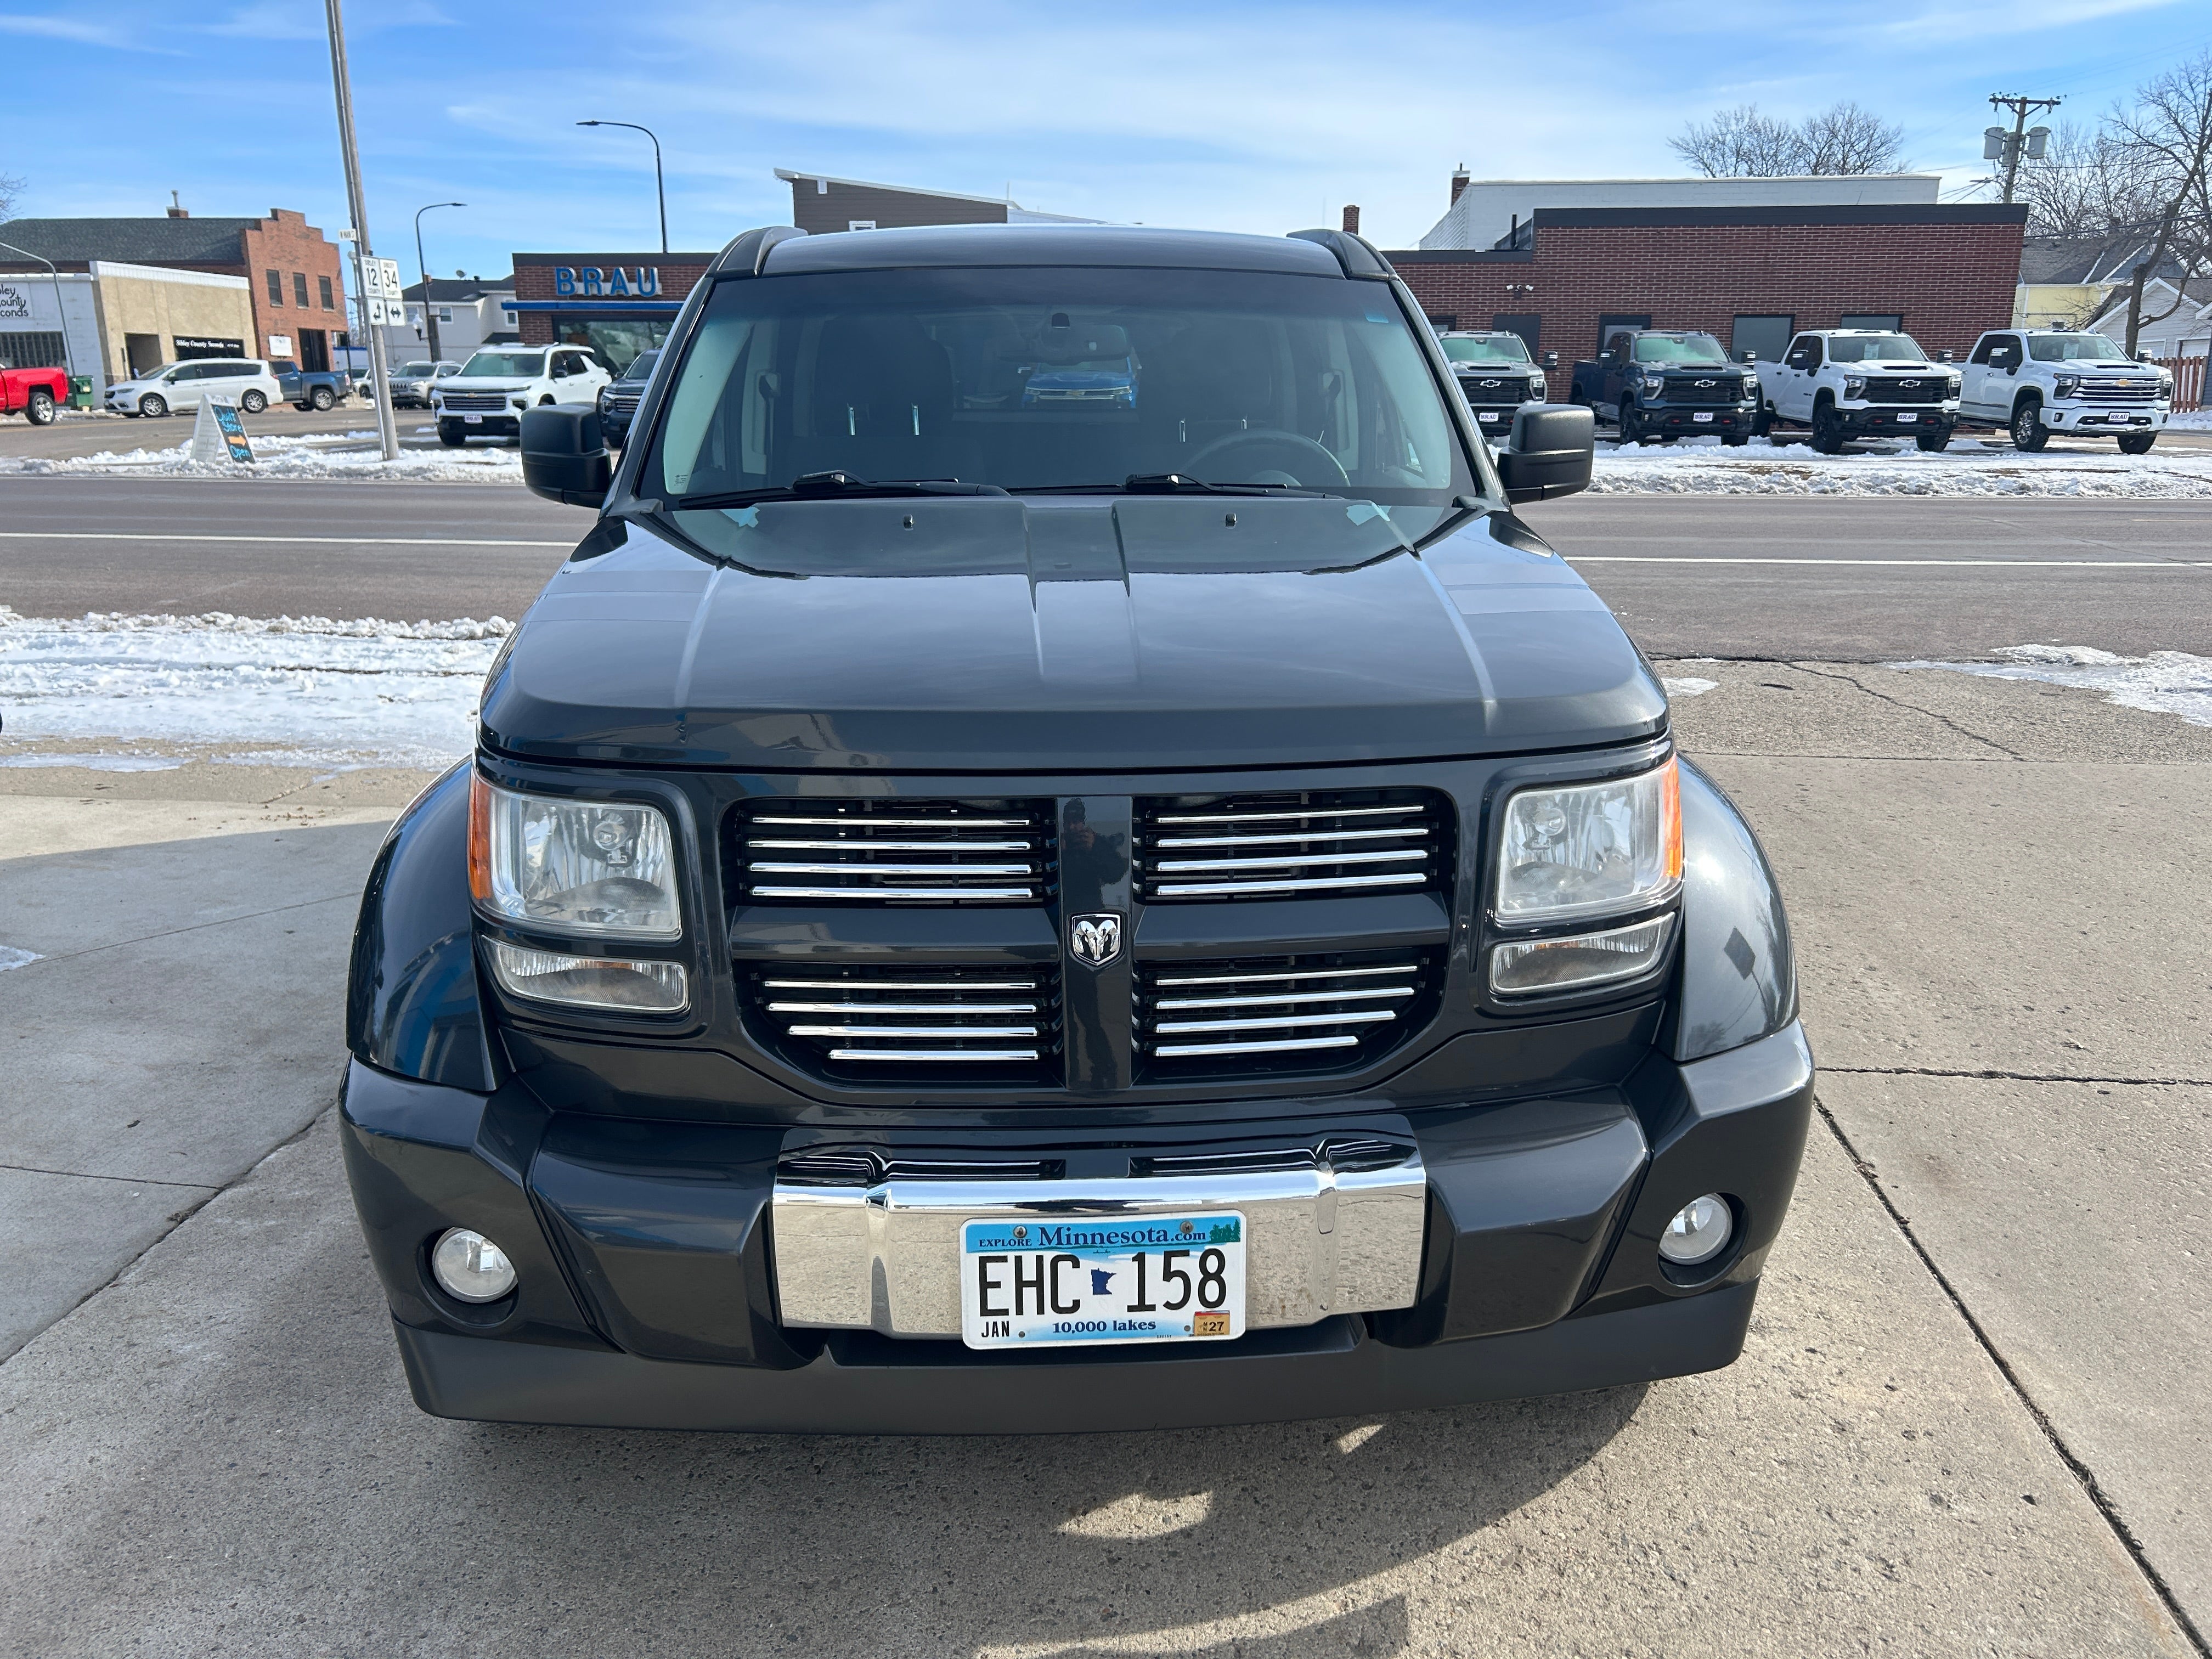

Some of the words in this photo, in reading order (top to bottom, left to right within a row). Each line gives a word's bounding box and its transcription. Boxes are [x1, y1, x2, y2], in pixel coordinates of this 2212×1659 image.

[366, 268, 378, 286] 12
[384, 270, 398, 288] 34
[555, 267, 658, 297] BRAU
[0, 294, 26, 309] ounty
[230, 445, 251, 460] Open
[979, 1238, 1032, 1247] EXPLORE
[1038, 1226, 1206, 1246] Minnesota.com
[979, 1254, 1081, 1317] EHC
[1127, 1248, 1227, 1312] 158
[981, 1321, 1009, 1338] JAN
[1052, 1321, 1107, 1334] 10,000
[1112, 1319, 1156, 1331] lakes
[1209, 1321, 1224, 1331] 27
